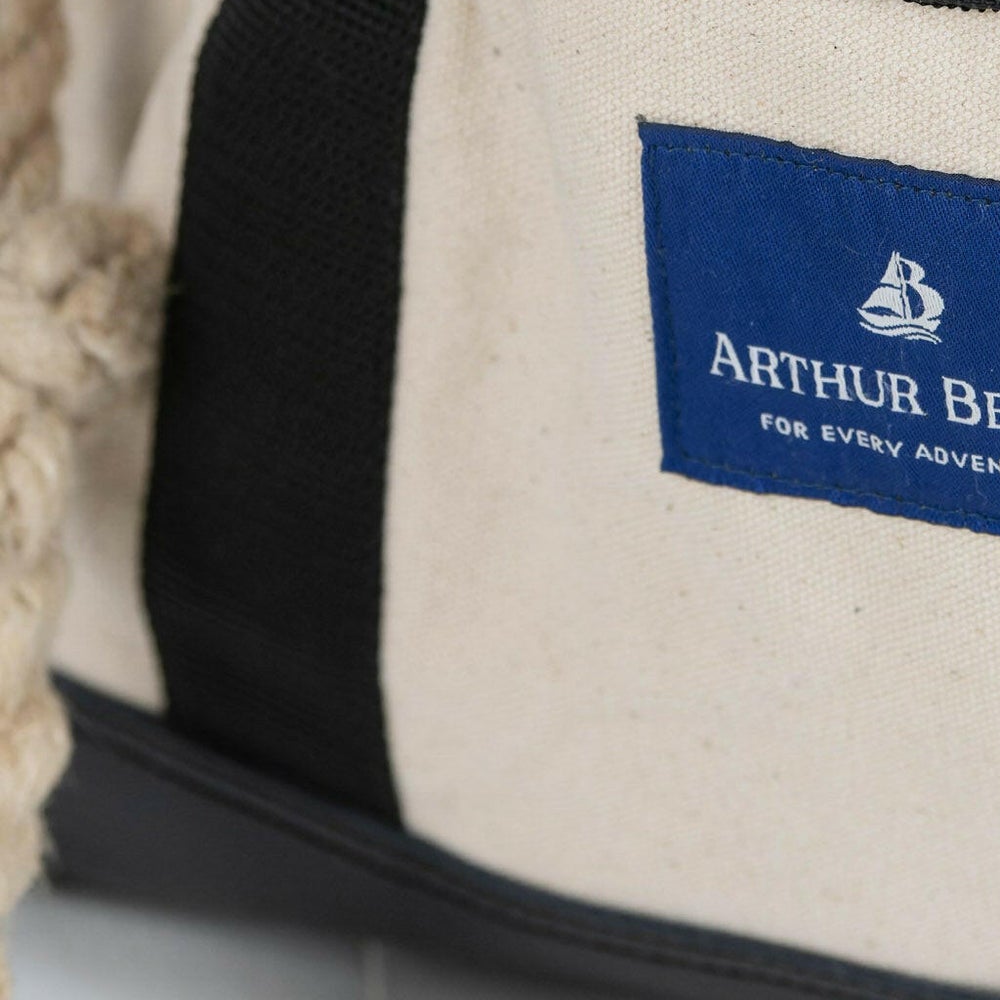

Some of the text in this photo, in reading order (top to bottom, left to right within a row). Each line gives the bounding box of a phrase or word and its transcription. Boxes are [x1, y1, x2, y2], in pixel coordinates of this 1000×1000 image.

[709, 331, 927, 416] ARTHUR
[760, 413, 810, 441] FOR
[821, 424, 903, 459] EVERY
